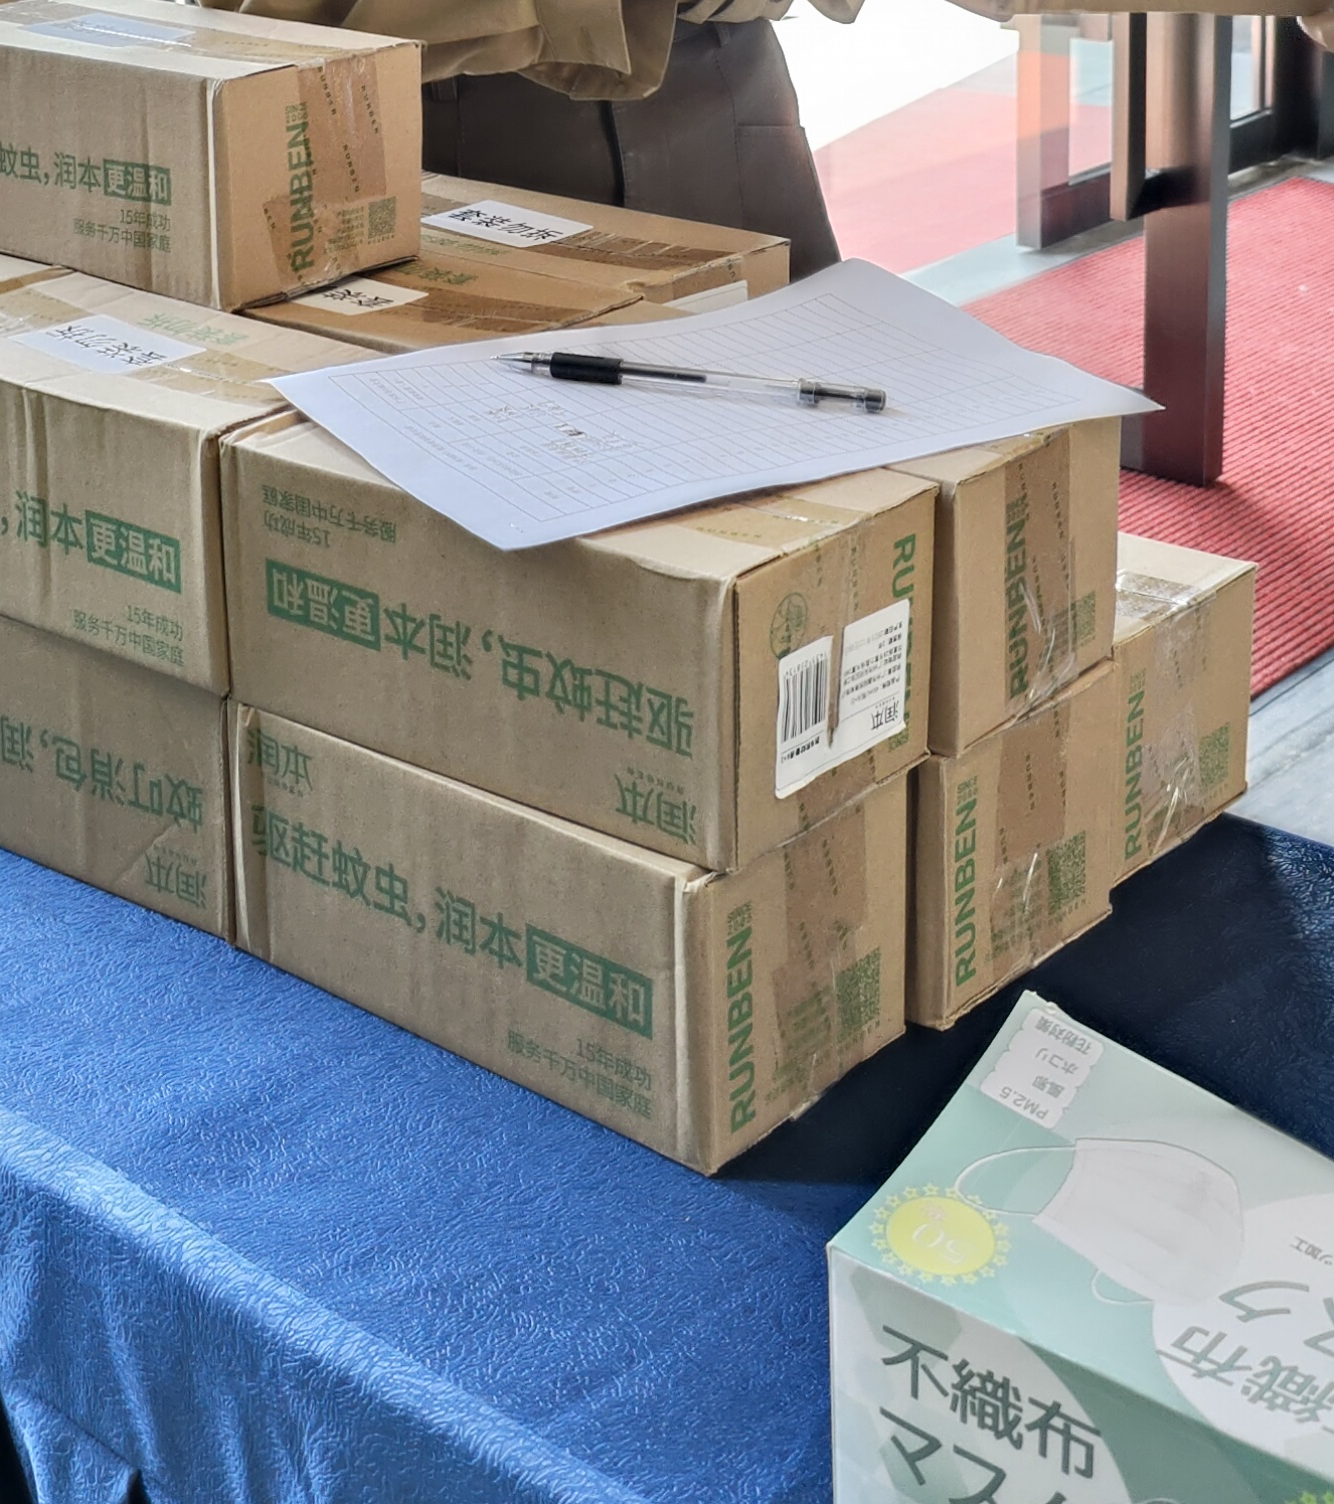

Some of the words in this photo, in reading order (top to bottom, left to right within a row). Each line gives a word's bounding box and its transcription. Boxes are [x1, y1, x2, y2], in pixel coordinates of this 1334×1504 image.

[120, 209, 171, 231] 15年成功
[286, 122, 315, 273] RUNBEN
[449, 208, 564, 242] 套装勿拆
[74, 218, 171, 253] 服务千万中国家庭
[46, 325, 168, 366] 套装勿拆
[262, 484, 396, 543] 服务千万中国家庭
[264, 511, 329, 548] 15年成功
[72, 608, 184, 668] 服务千万中国家庭
[126, 605, 183, 642] 15年成功
[1005, 519, 1029, 699] RUNBEN
[265, 557, 694, 760] 驱赶蚊虫，润本更温和
[872, 700, 899, 731] 润本
[246, 729, 313, 792] 润本
[1125, 690, 1145, 860] RUNBEN
[613, 773, 697, 844] 润本
[144, 853, 208, 909] 润本
[954, 798, 977, 986] RUNBEN
[251, 804, 653, 1039] 驱赶蚊虫，润本更温和
[727, 927, 755, 1133] RUNBEN
[1035, 1044, 1080, 1076] ホコリ
[506, 1029, 653, 1120] 服务千万中国家庭
[576, 1037, 653, 1089] 15年成功
[998, 1085, 1049, 1122] PM2.5
[881, 1324, 1102, 1479] 不織布
[879, 1405, 1068, 1504] マス
